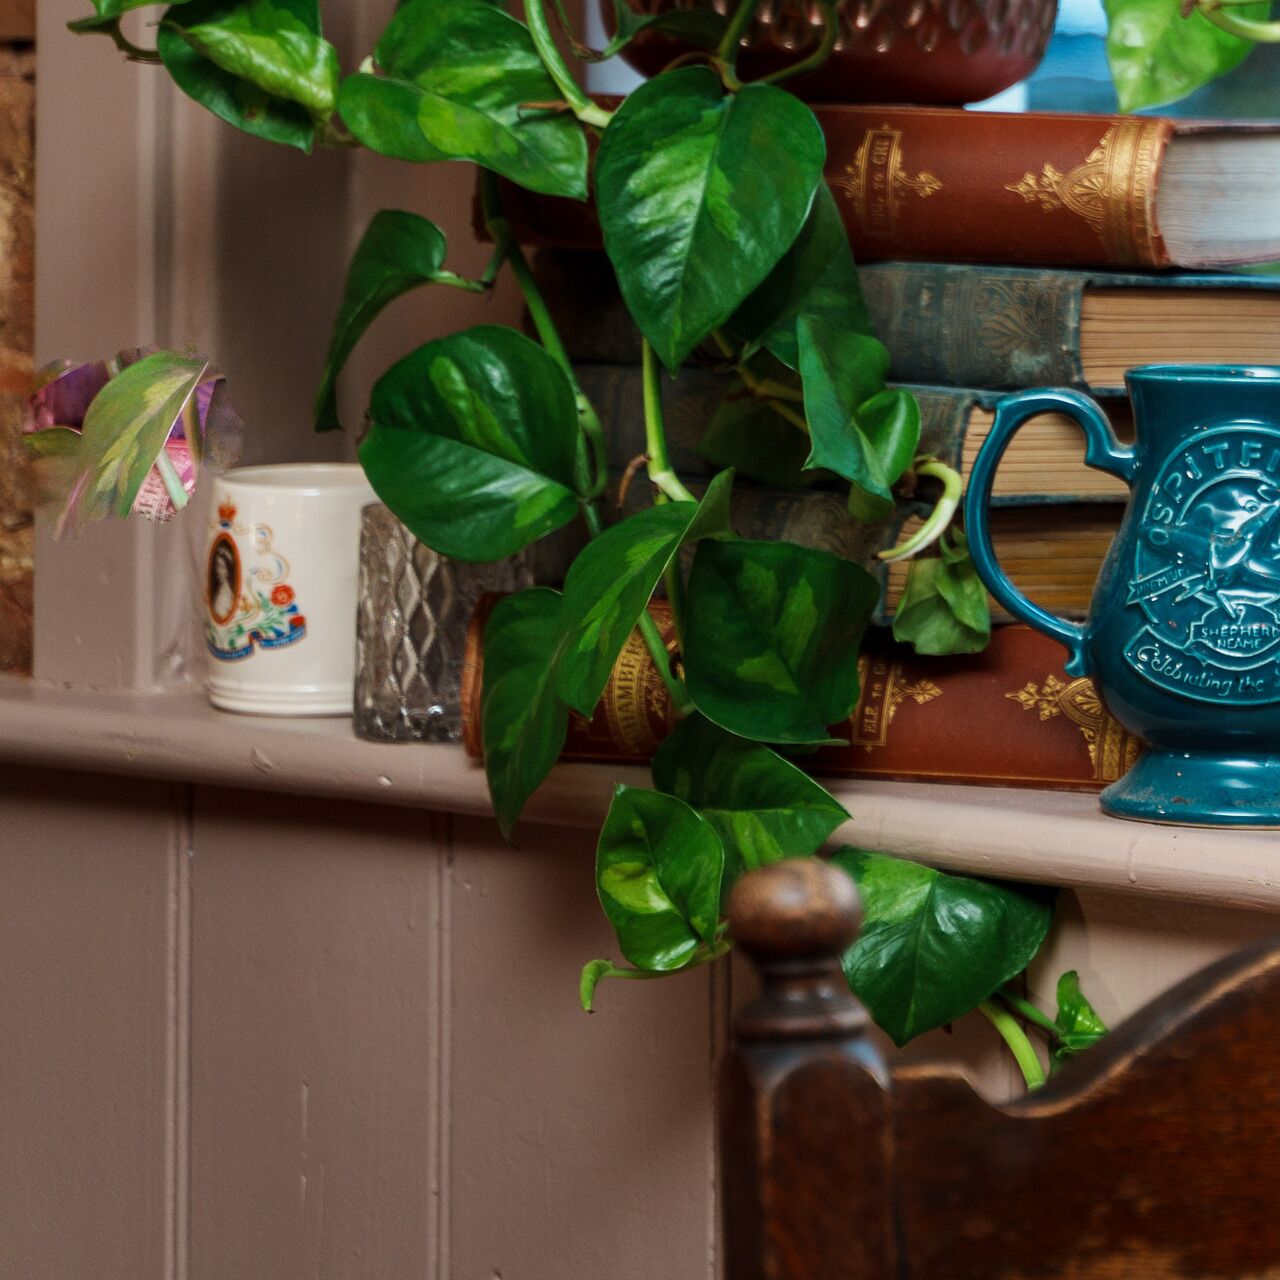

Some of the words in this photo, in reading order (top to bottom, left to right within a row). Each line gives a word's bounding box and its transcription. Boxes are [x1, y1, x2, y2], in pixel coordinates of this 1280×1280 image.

[1216, 637, 1262, 649] NEAME
[1136, 643, 1233, 696] Celebrating
[1237, 675, 1265, 693] the
